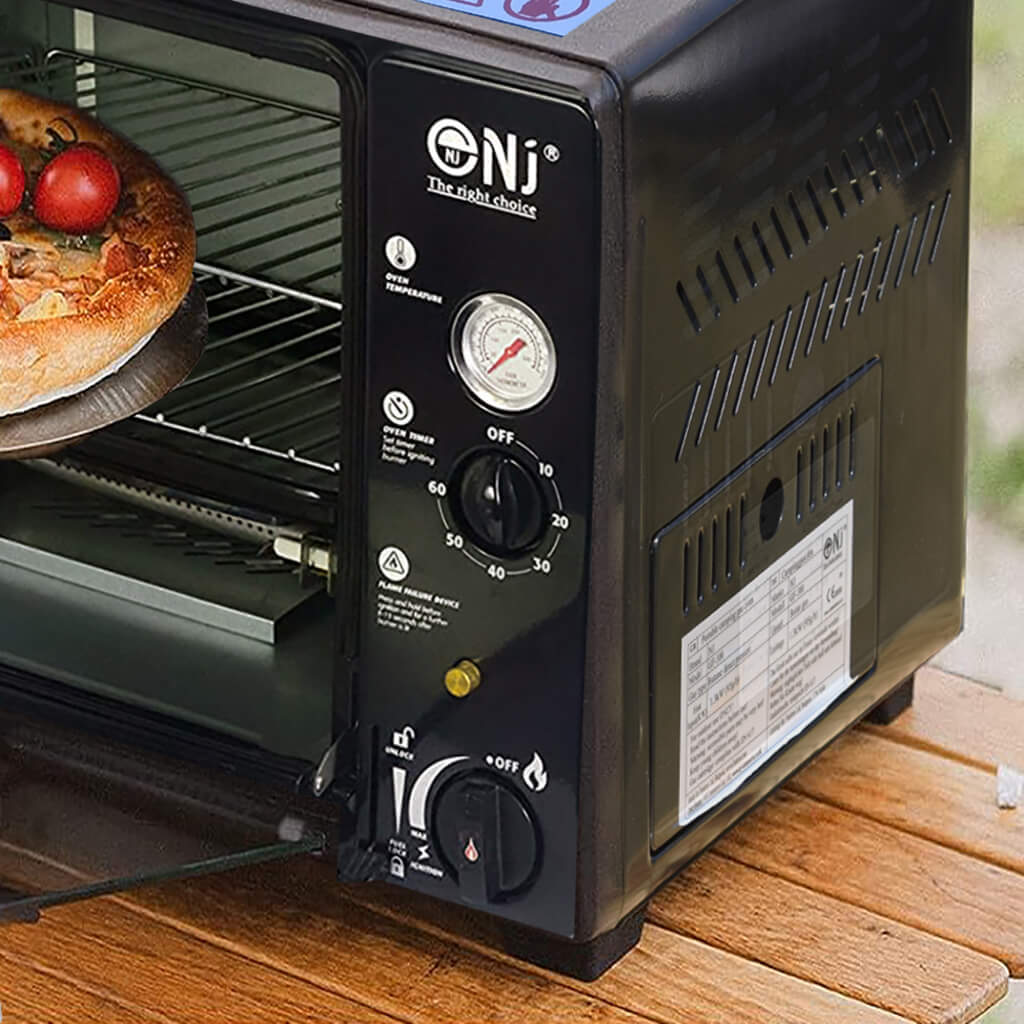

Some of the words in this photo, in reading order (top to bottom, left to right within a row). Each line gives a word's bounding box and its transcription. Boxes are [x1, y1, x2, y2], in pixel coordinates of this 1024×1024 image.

[427, 175, 455, 194] The
[456, 184, 490, 204] right
[492, 194, 537, 217] choice
[385, 272, 409, 285] OVEN
[385, 282, 443, 305] TEMPERATURE
[383, 425, 407, 438] OVEN
[487, 426, 516, 445] OFF
[538, 462, 554, 477] 10
[427, 480, 447, 496] 60
[551, 513, 569, 529] 20
[445, 532, 463, 549] 50
[487, 564, 506, 580] 40
[532, 557, 551, 573] 30
[384, 746, 415, 761] UNLOCK
[495, 756, 521, 774] OFF
